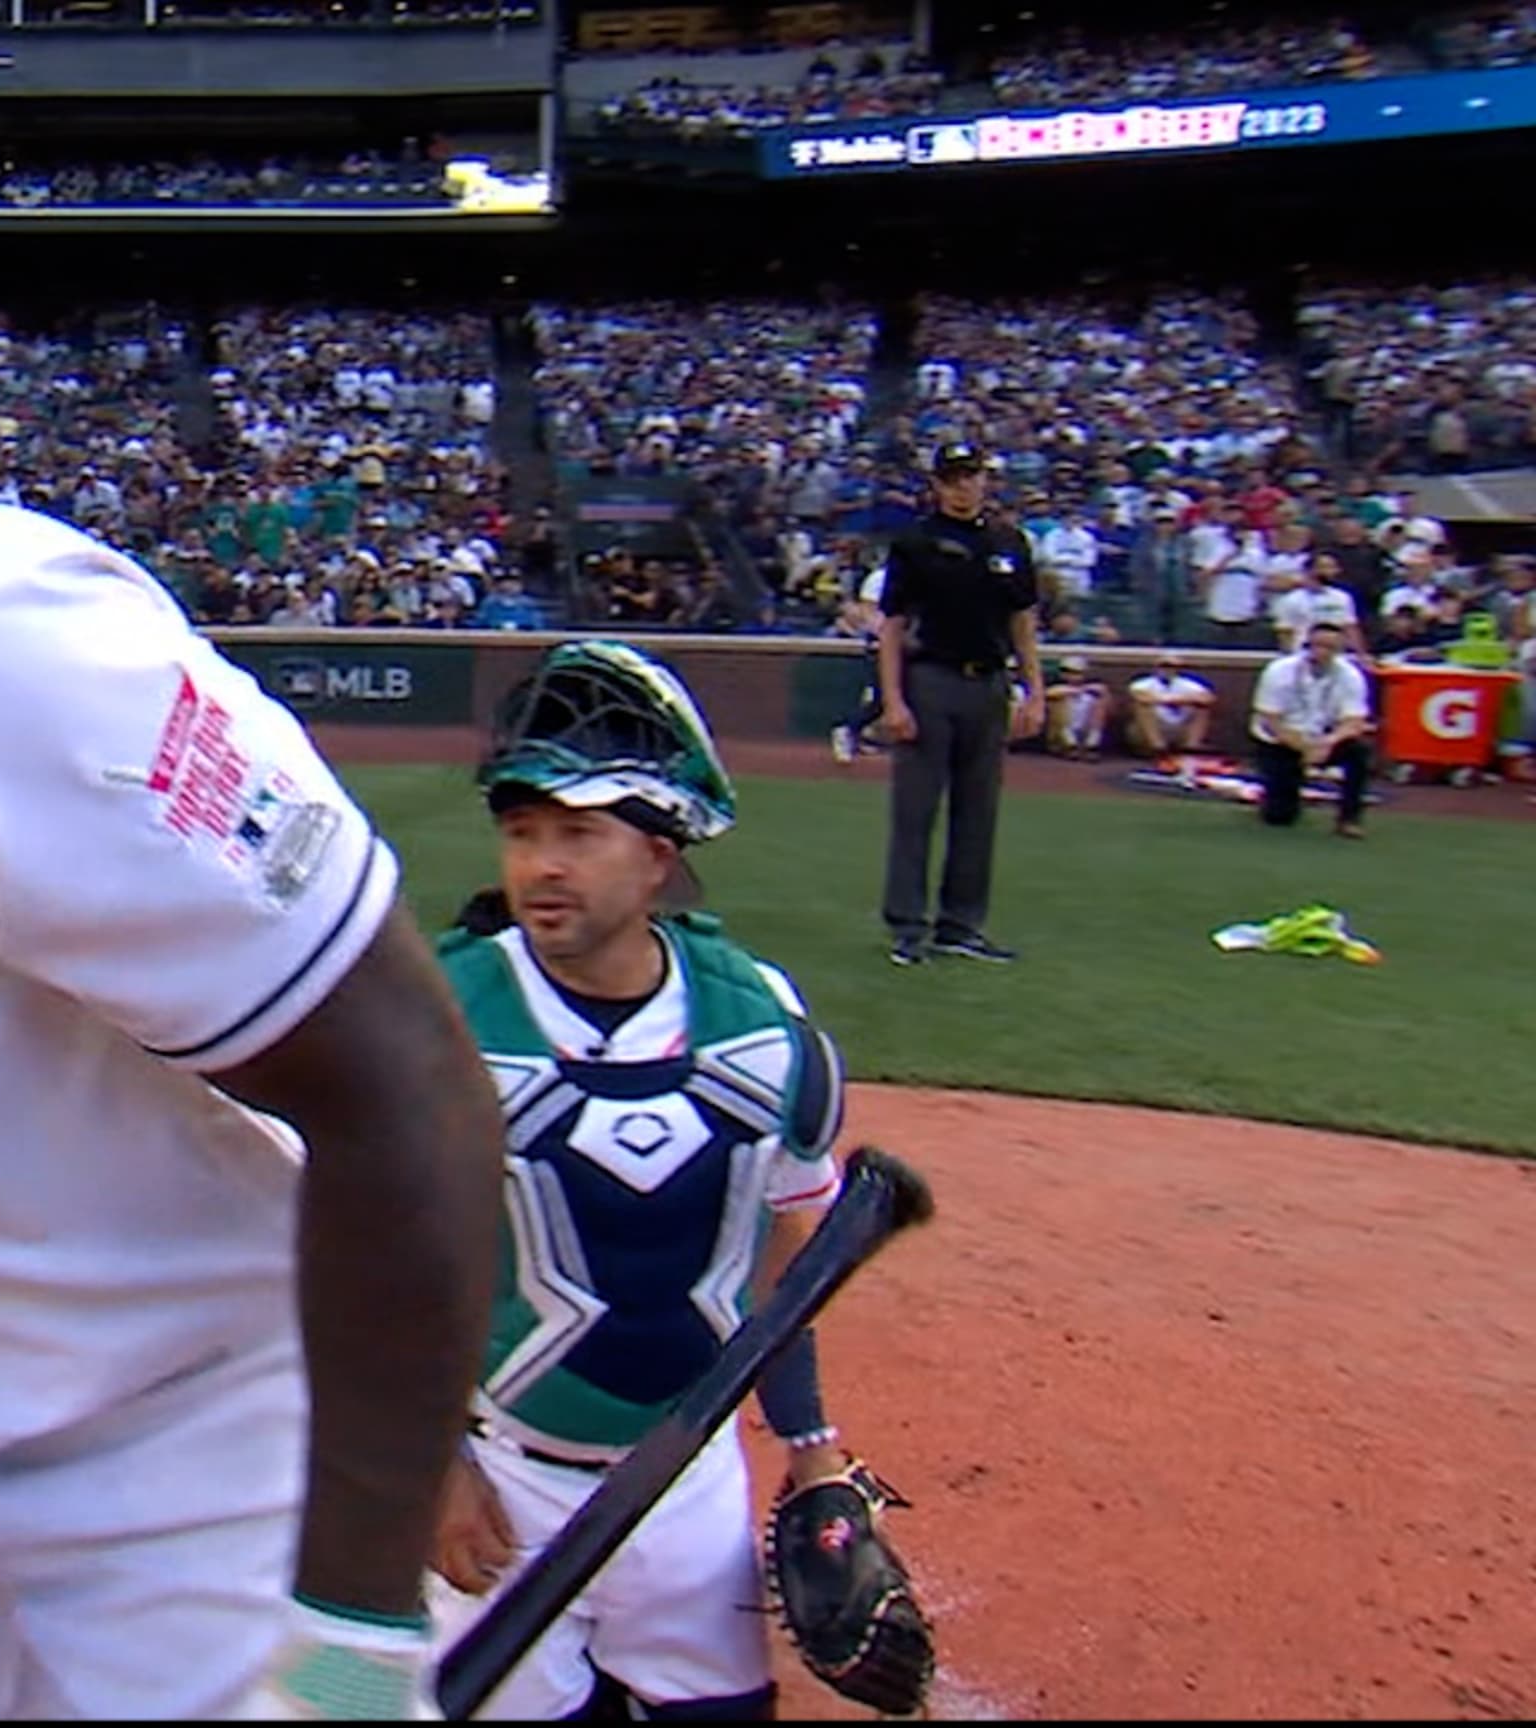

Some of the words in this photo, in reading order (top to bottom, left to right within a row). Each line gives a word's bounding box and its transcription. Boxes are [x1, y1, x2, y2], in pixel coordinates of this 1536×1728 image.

[1242, 104, 1326, 138] 2023
[327, 667, 412, 699] MLB
[1420, 688, 1480, 740] G
